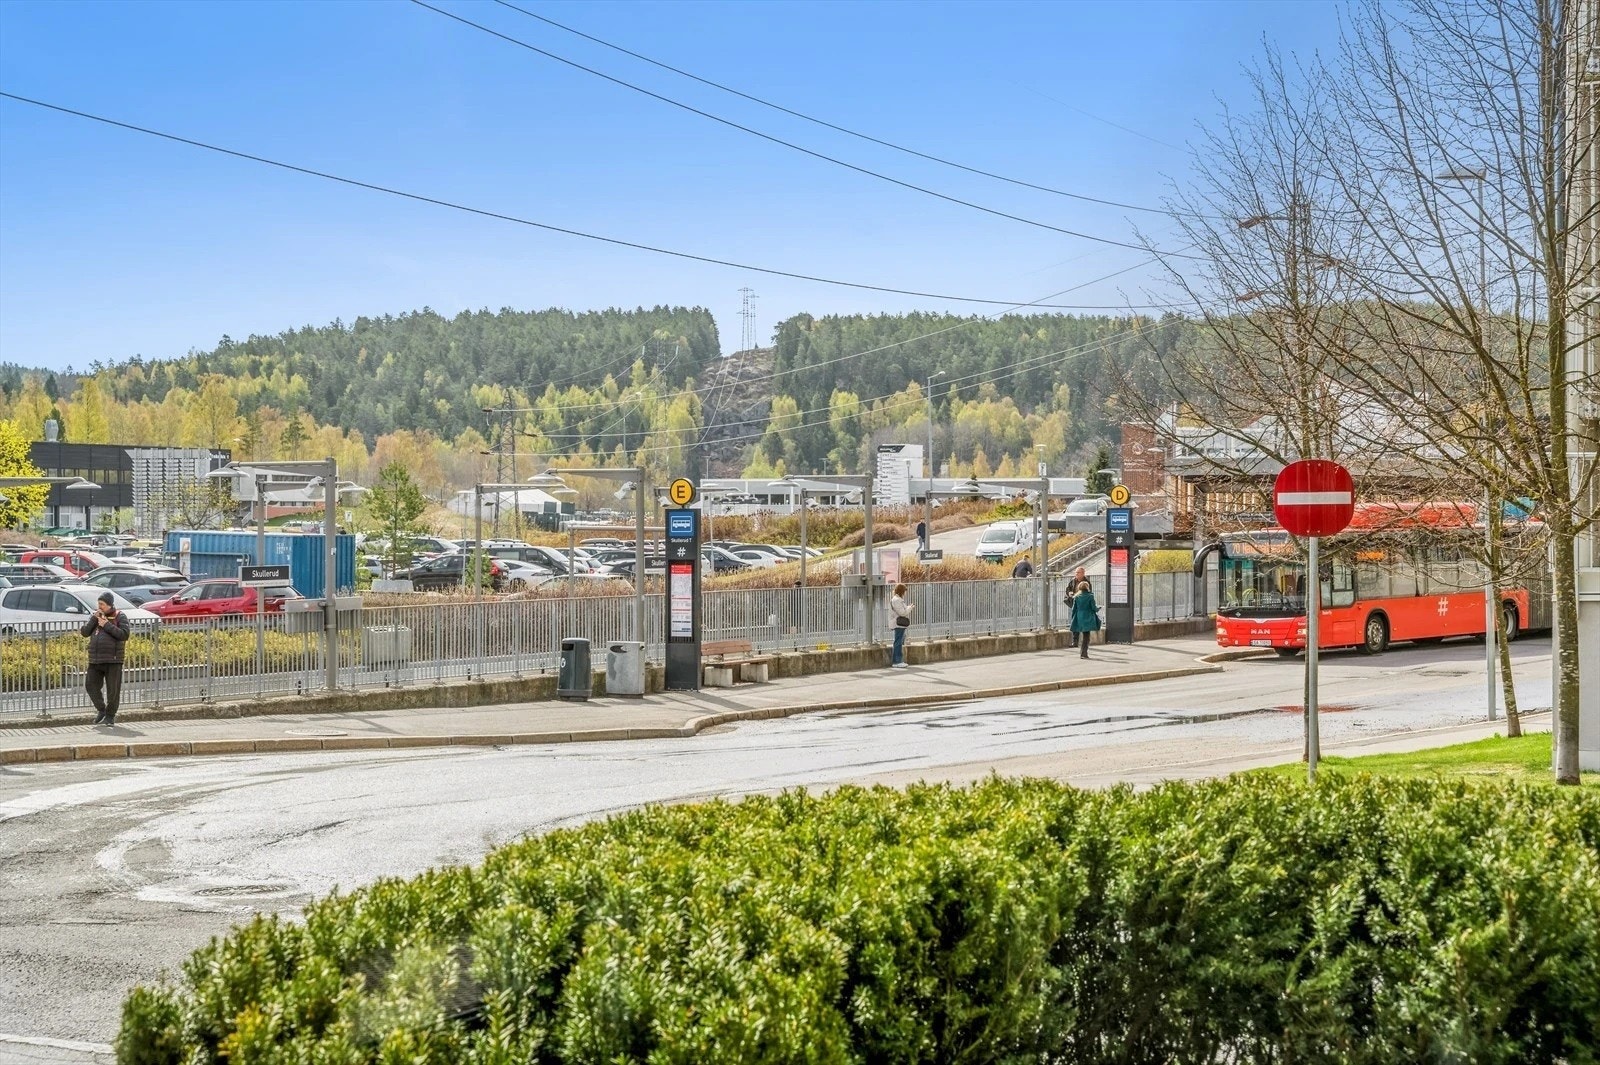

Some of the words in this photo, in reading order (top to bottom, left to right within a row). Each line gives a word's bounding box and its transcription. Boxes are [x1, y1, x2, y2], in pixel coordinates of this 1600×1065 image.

[676, 486, 686, 498] E
[1116, 490, 1124, 500] D
[252, 569, 279, 578] Skullerud
